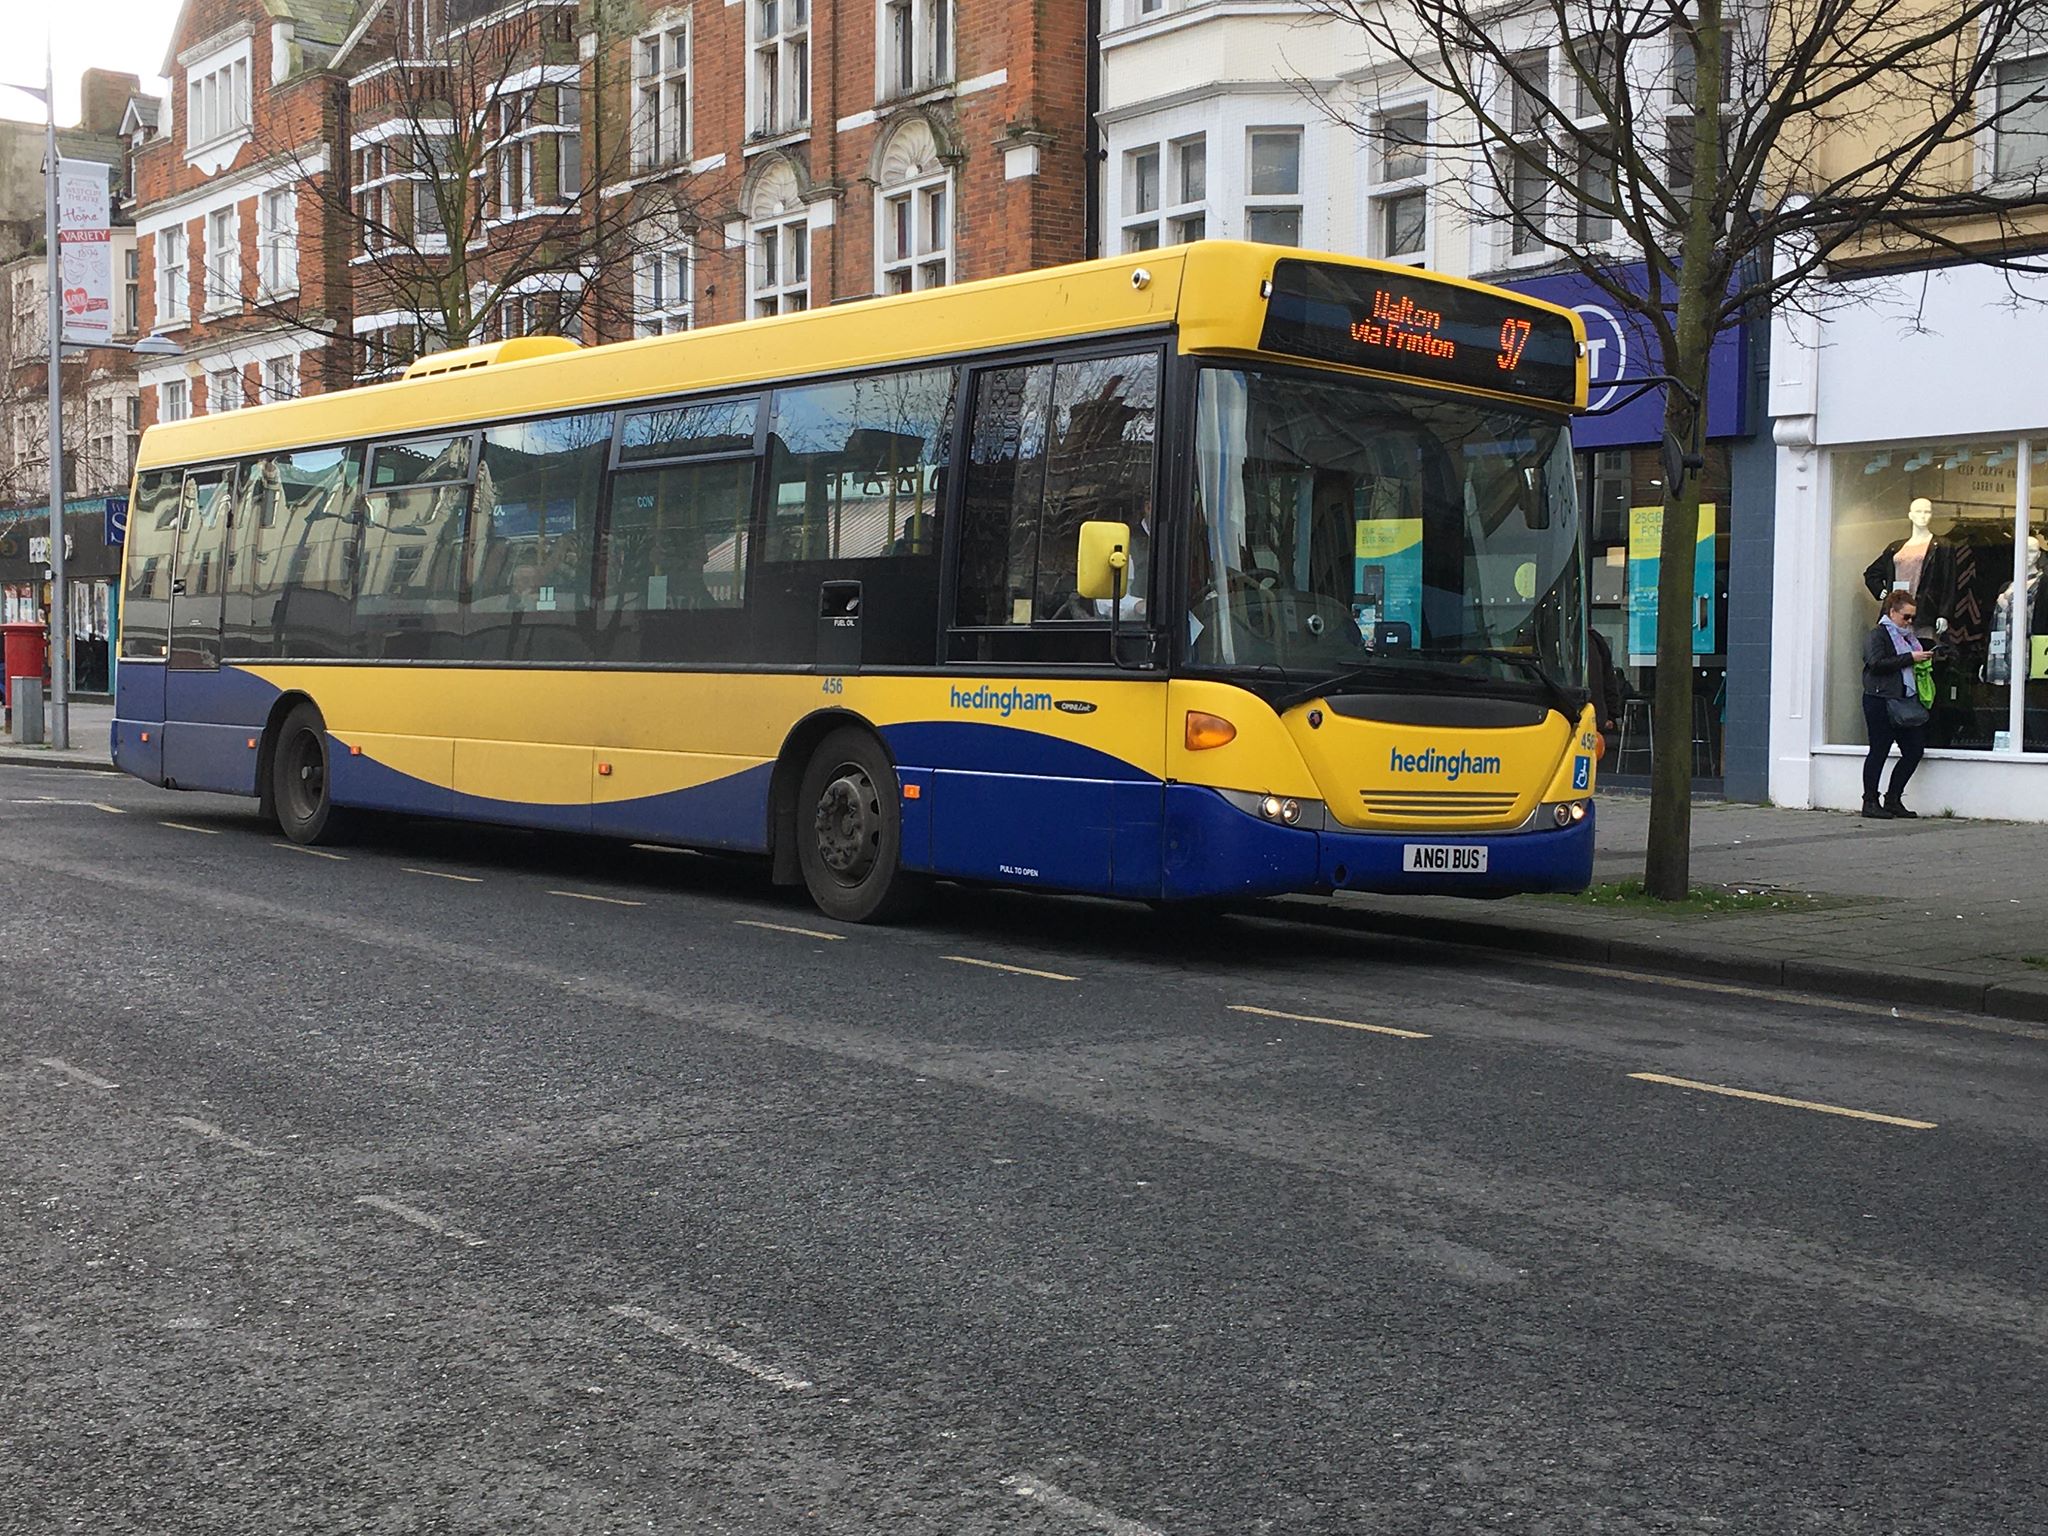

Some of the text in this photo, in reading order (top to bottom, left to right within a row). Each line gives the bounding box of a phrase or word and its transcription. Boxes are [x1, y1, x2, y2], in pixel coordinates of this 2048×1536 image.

[63, 208, 98, 222] Home
[62, 230, 106, 241] VARIETY
[1372, 289, 1441, 330] Walton
[1350, 318, 1456, 359] via Frinton
[1497, 318, 1532, 370] 97
[1634, 511, 1662, 524] 25GB
[833, 619, 855, 627] FUEL OIL
[822, 677, 843, 694] 456
[950, 684, 1052, 717] hedingham
[1390, 745, 1501, 781] hedingham
[1413, 848, 1480, 869] AN61 BUS
[1000, 864, 1039, 877] PULL TO OPEN
